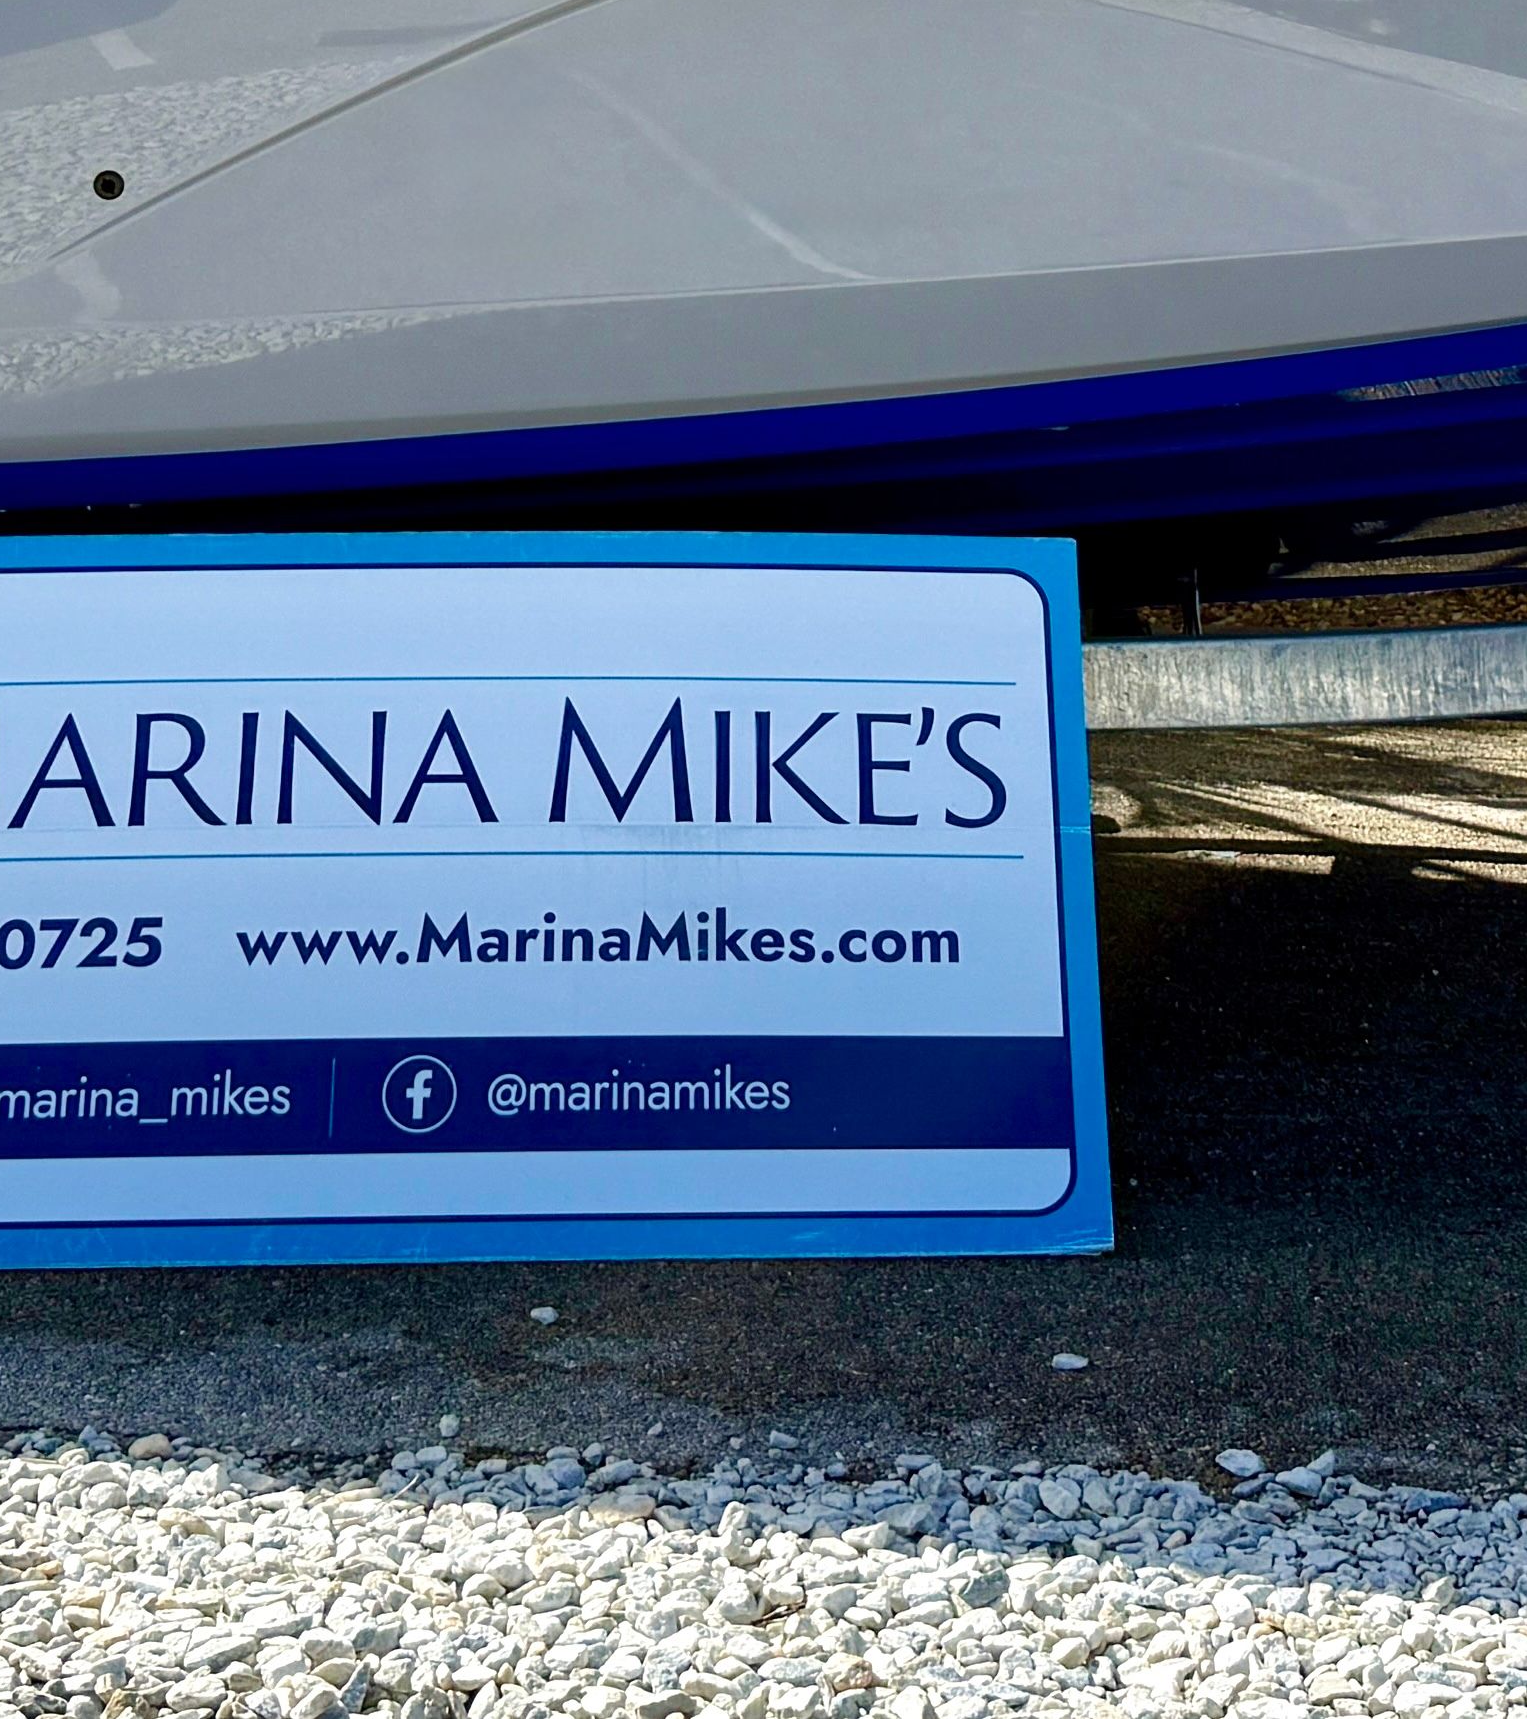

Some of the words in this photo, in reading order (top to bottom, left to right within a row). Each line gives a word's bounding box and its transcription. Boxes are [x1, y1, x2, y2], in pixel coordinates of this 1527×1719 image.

[548, 696, 1007, 829] MIKE'S
[236, 906, 960, 966] www.MarinaMikes.com
[487, 1063, 791, 1116] @marinamikes
